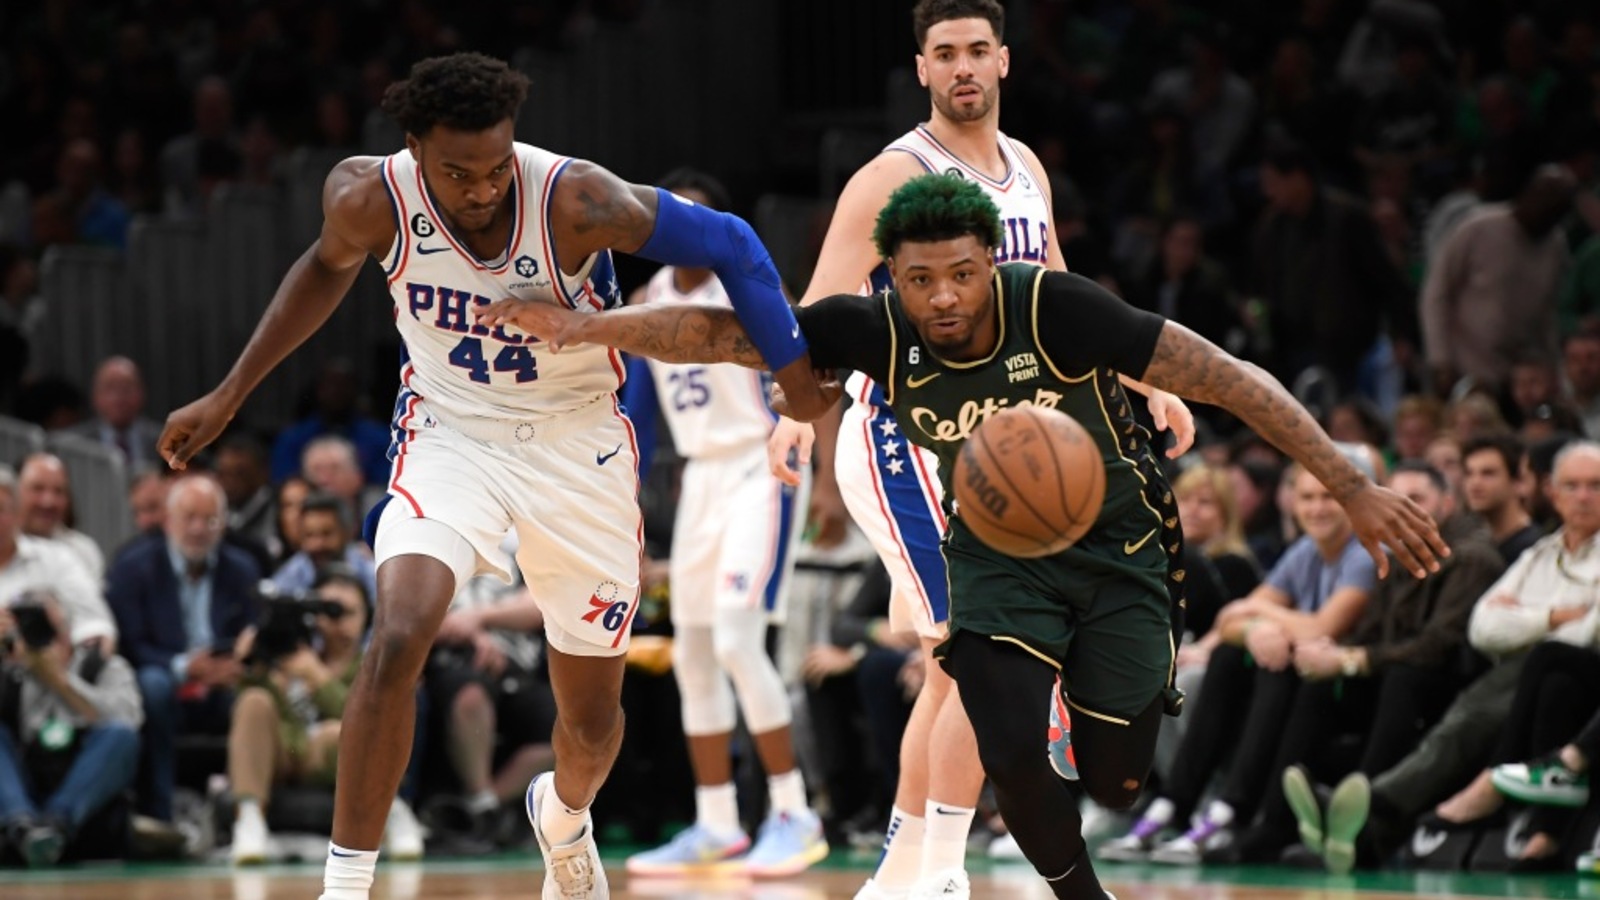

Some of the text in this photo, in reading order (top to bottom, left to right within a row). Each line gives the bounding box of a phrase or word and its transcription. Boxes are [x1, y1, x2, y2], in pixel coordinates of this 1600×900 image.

[417, 216, 430, 234] 6
[448, 336, 538, 384] 44
[908, 346, 920, 364] 6
[1004, 353, 1038, 371] VISTA
[1008, 366, 1040, 383] PRINT
[669, 368, 710, 411] 25
[580, 593, 628, 631] 76
